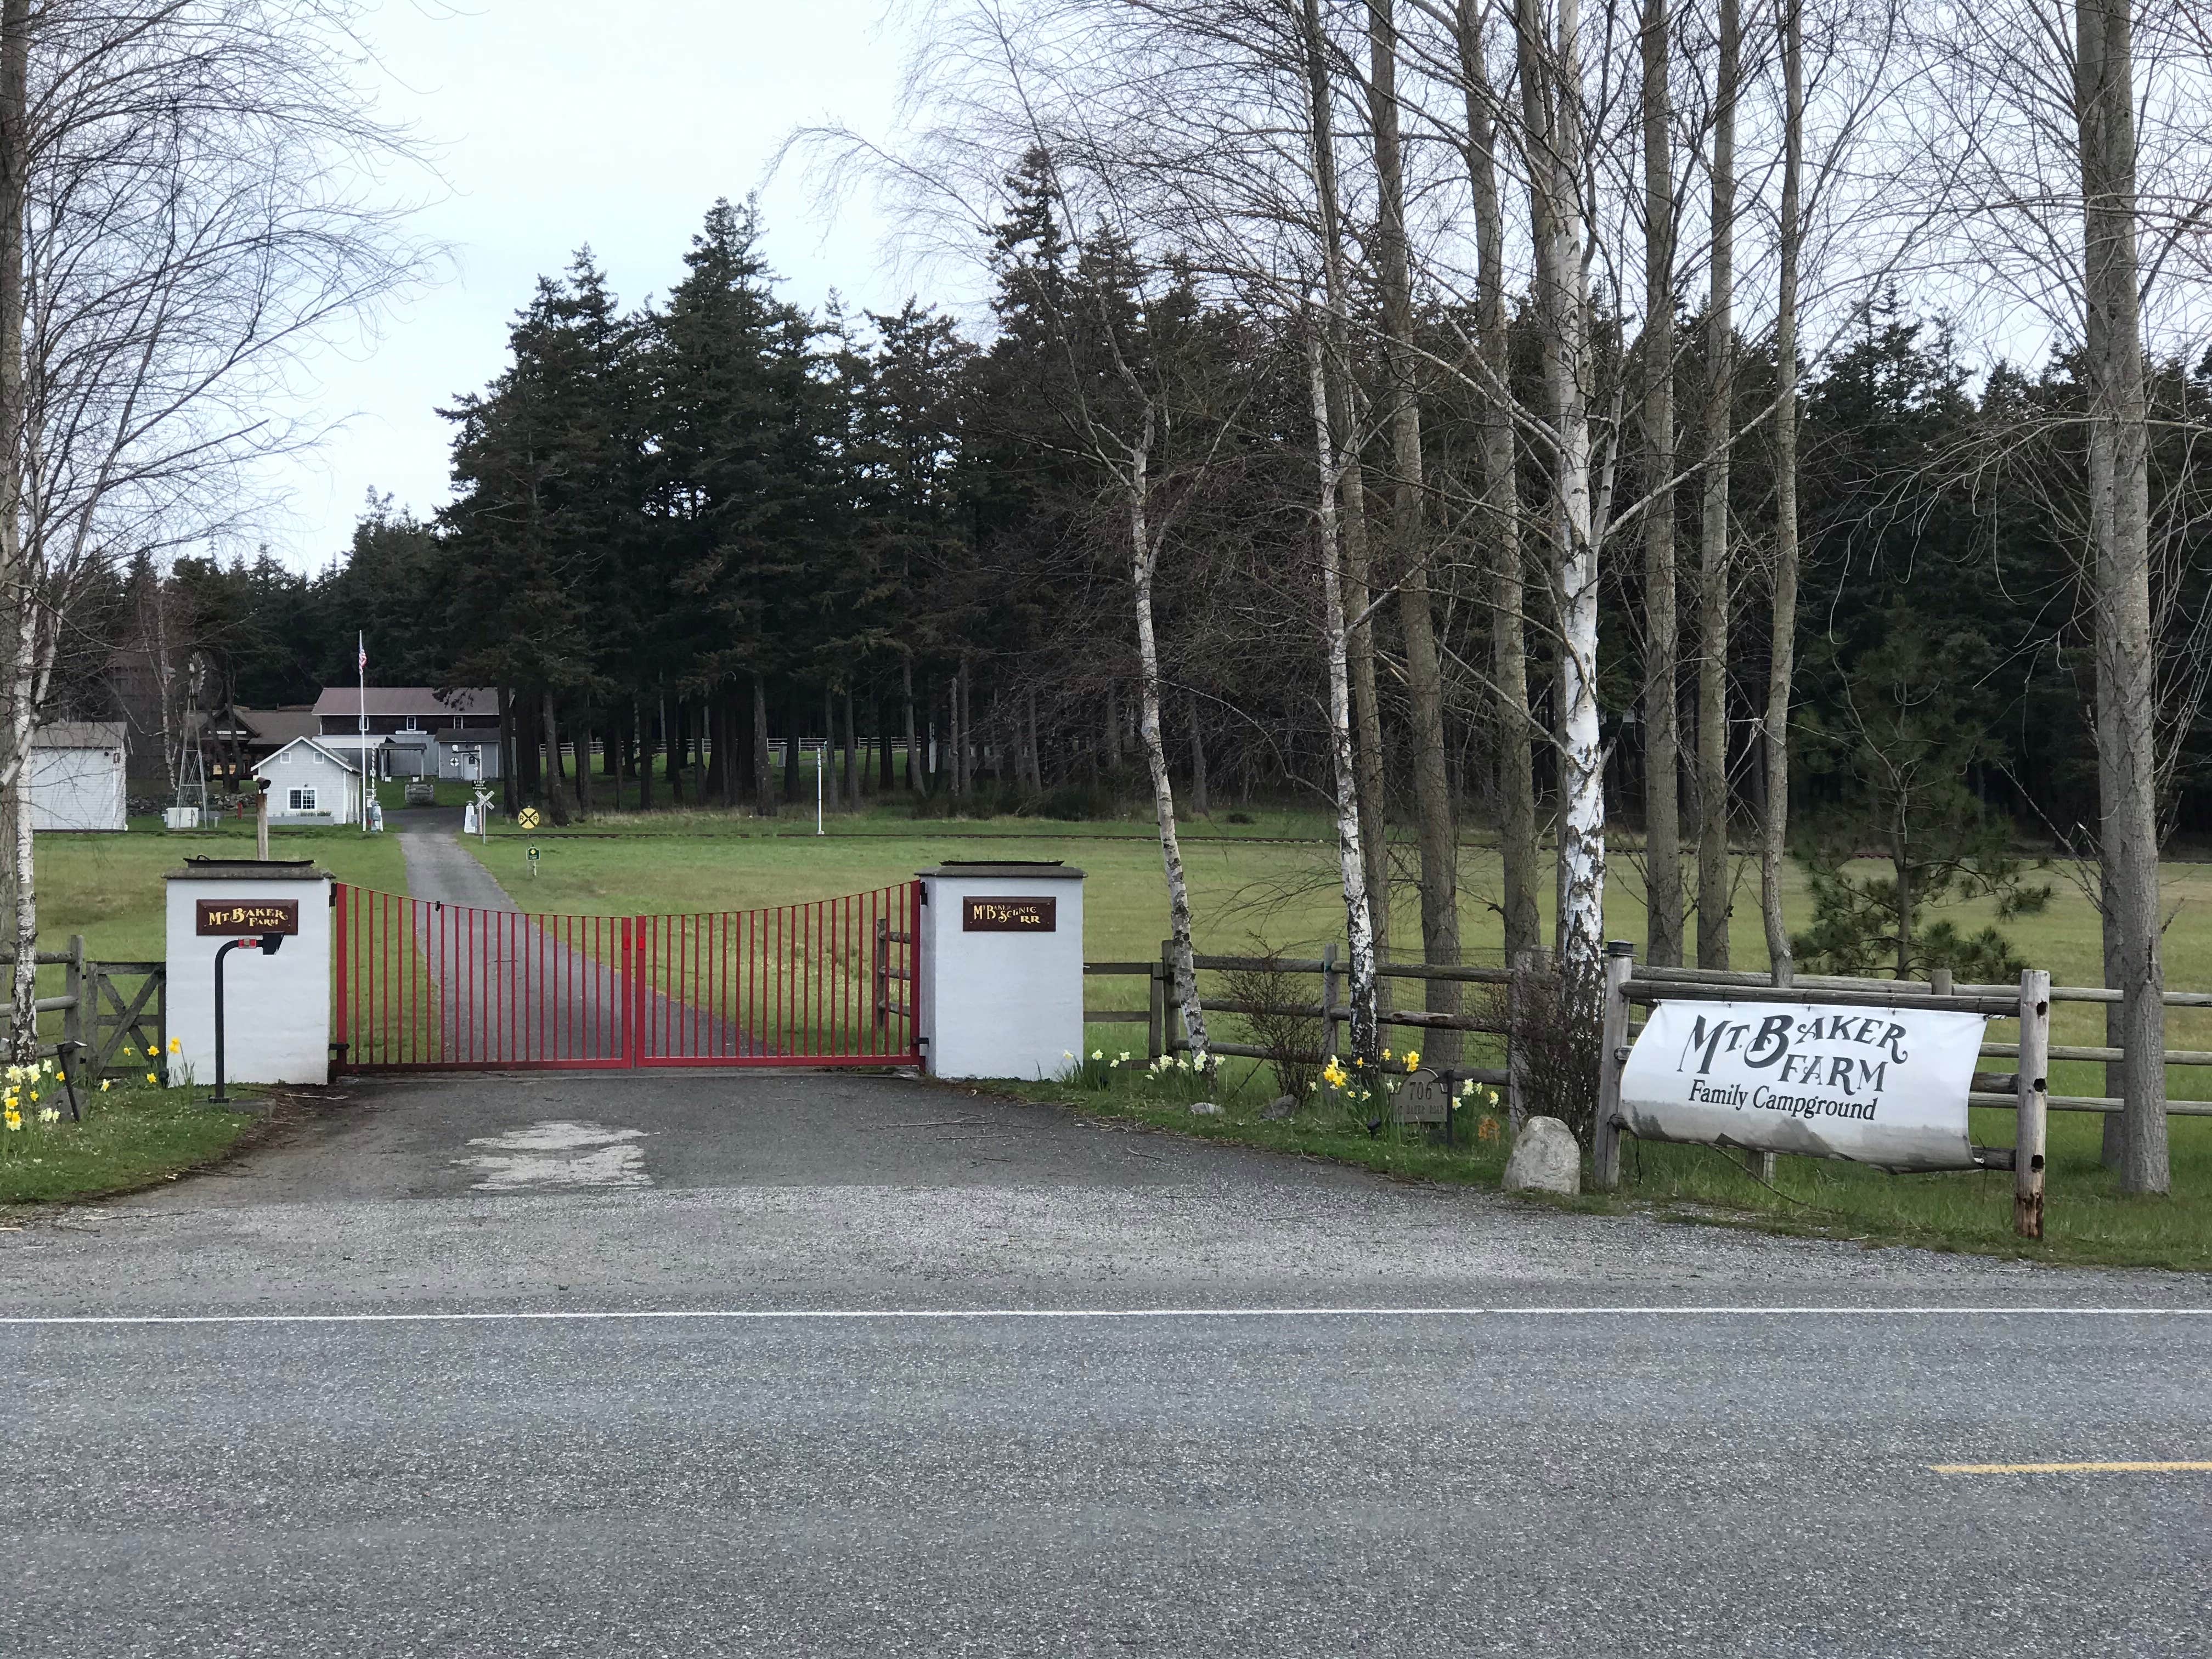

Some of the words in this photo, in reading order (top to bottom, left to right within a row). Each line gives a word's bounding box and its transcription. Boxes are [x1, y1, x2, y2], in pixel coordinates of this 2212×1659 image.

[230, 907, 289, 923] BAKER
[249, 917, 278, 927] FARM
[1020, 916, 1041, 924] RR
[1744, 1014, 1908, 1069] BAKER
[1778, 1054, 1889, 1096] FARM
[1409, 1081, 1432, 1101] 706
[1689, 1079, 1749, 1111] Family
[1753, 1085, 1878, 1120] Campground
